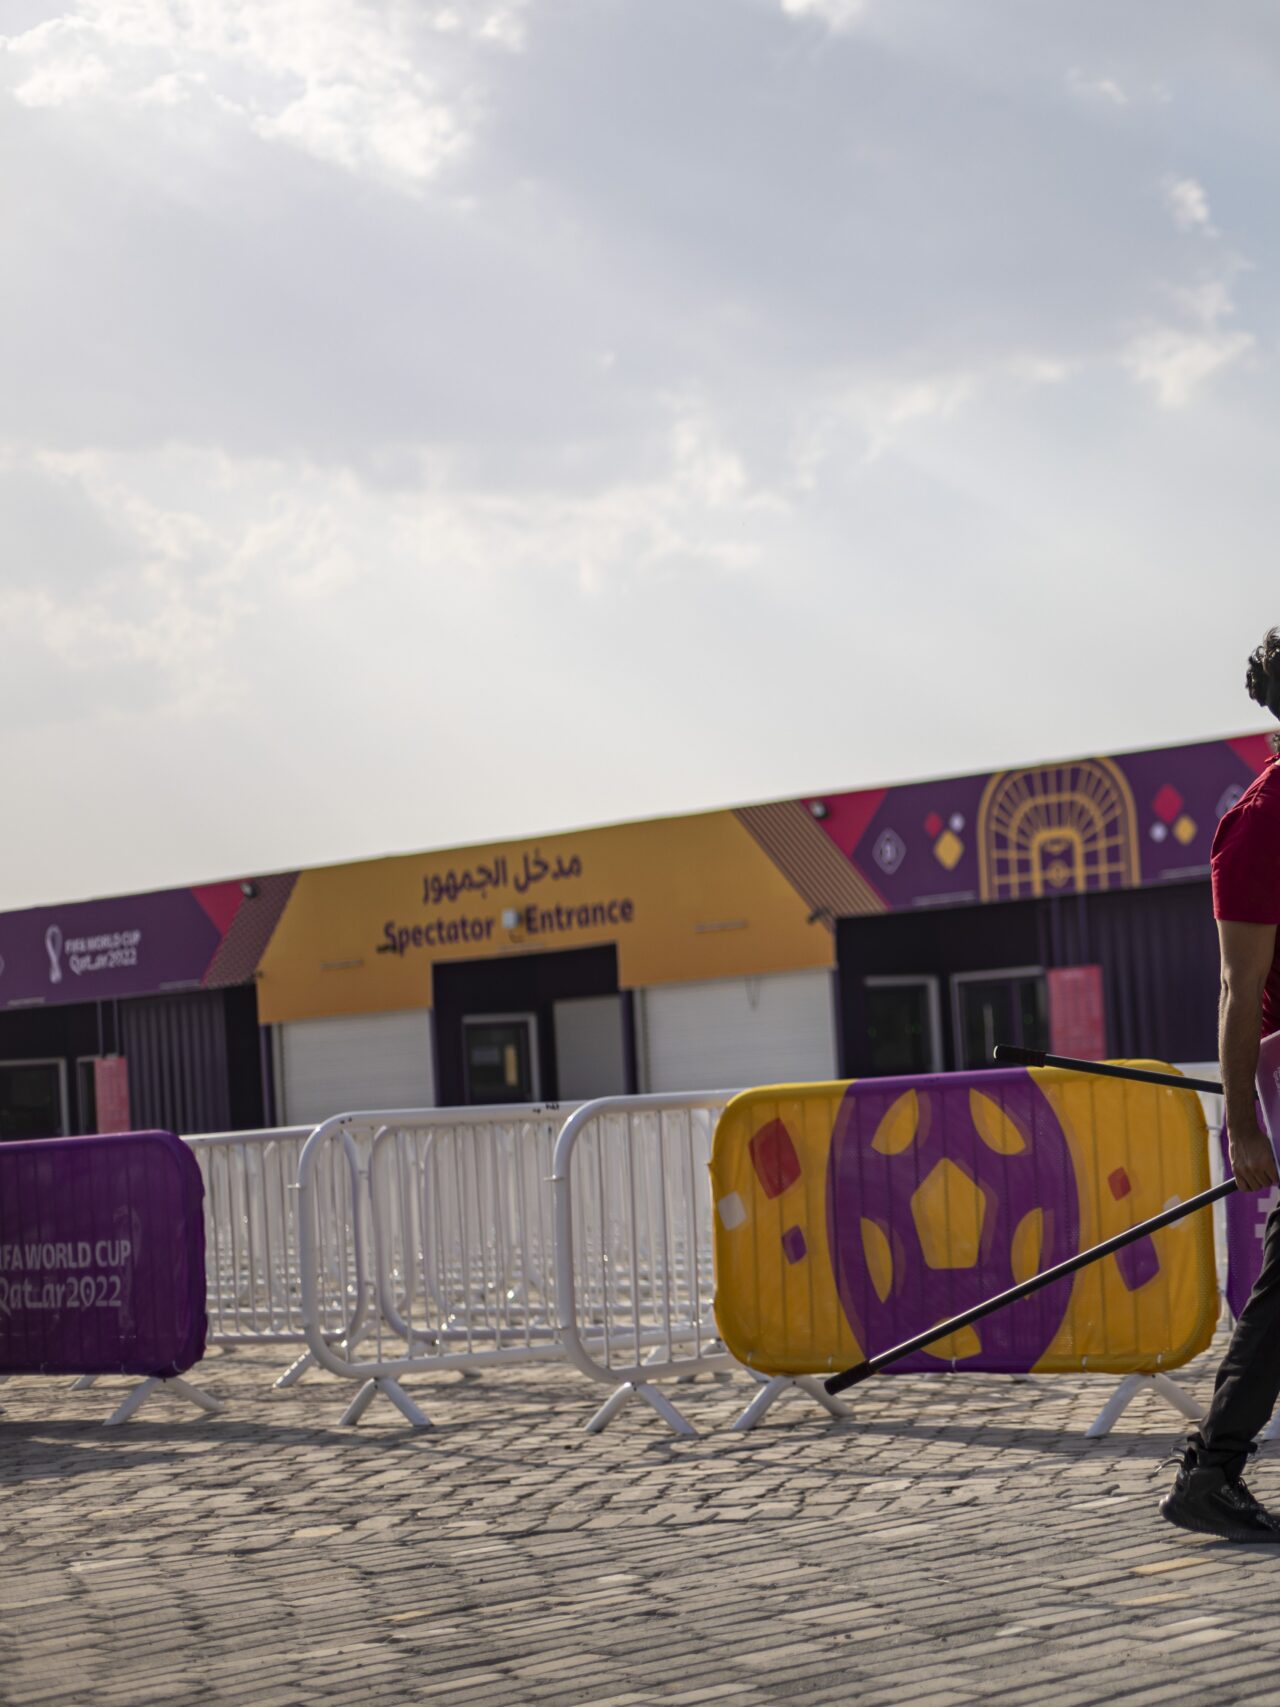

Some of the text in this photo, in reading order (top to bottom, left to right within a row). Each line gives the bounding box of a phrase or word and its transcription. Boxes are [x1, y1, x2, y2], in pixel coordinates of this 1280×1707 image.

[421, 847, 583, 906] مدخل الجمهور
[384, 898, 635, 957] Spectator Entrance
[24, 1241, 91, 1269] WORLD
[95, 1239, 131, 1267] CUP
